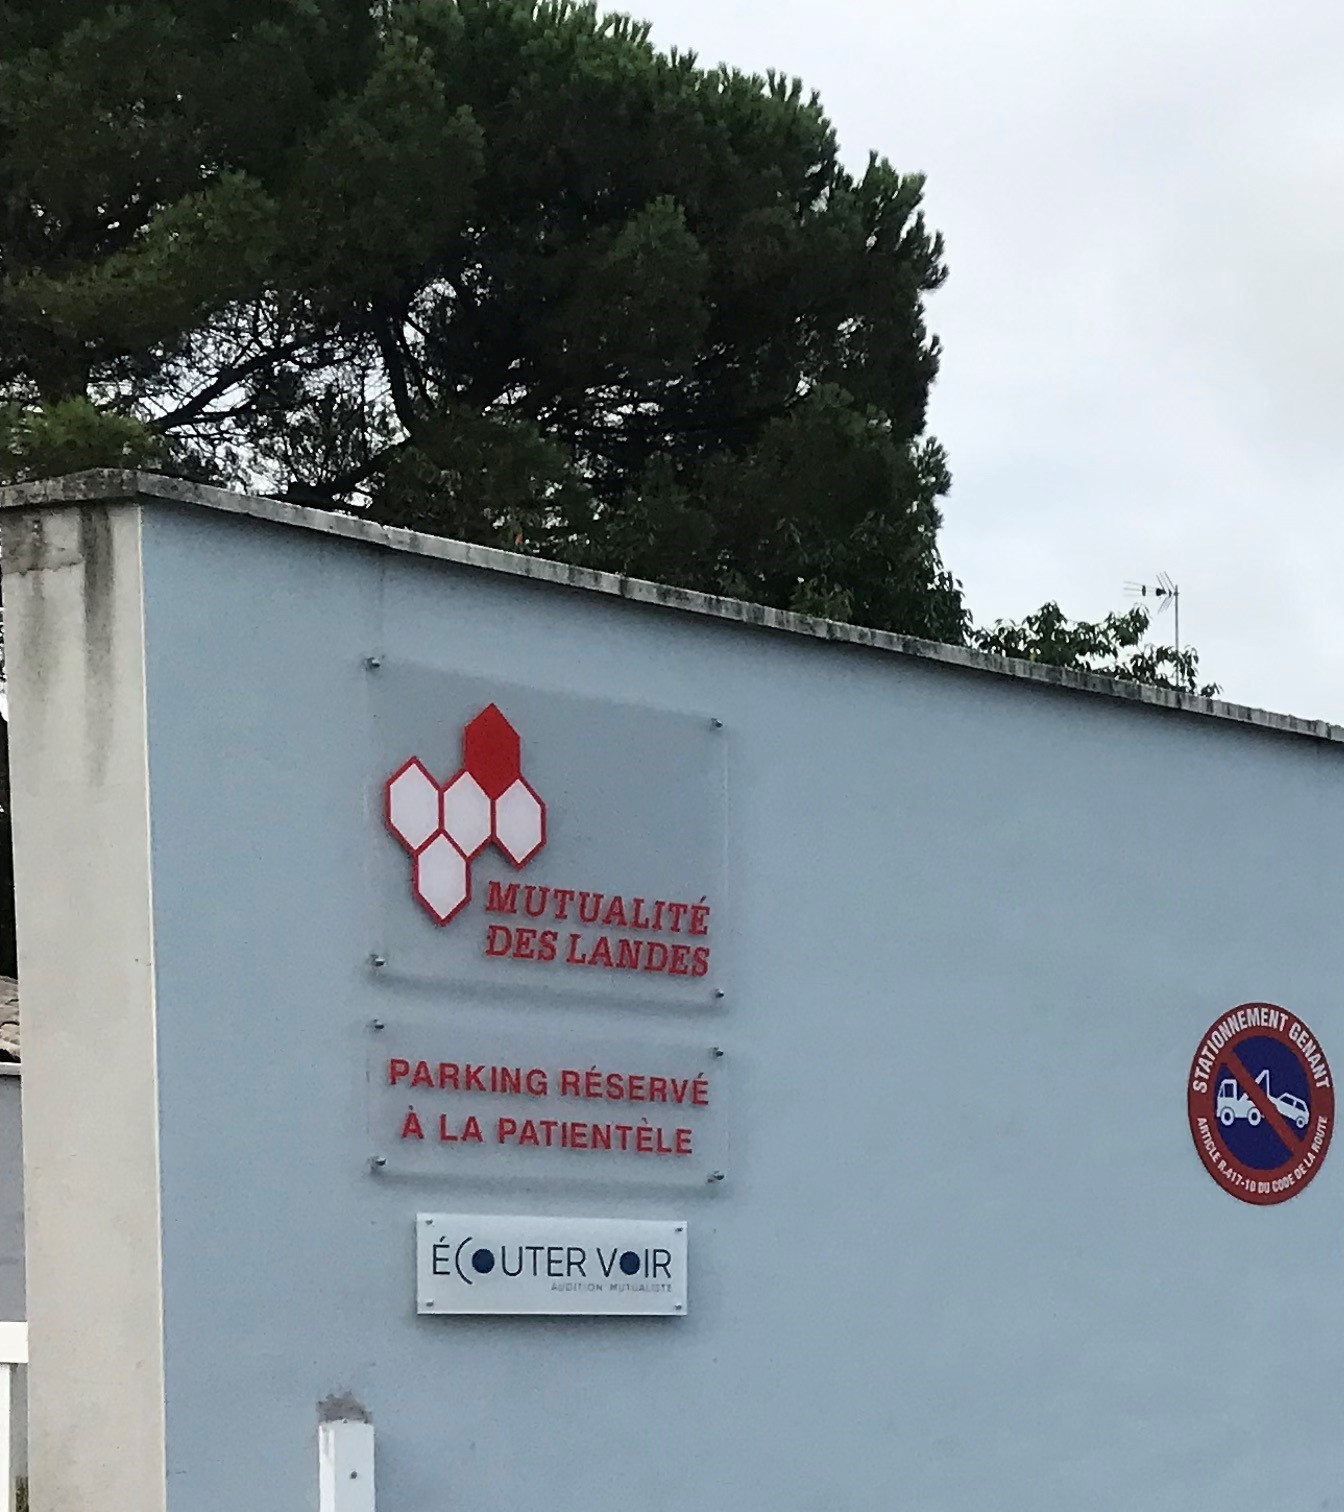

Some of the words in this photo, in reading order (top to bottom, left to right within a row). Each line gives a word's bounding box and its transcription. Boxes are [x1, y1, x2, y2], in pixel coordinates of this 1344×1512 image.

[486, 881, 711, 936] MUTUALITÉ
[485, 924, 559, 961] DES
[565, 933, 711, 977] LANDES
[1193, 1007, 1289, 1094] STATIONNEMENT
[1288, 1022, 1331, 1089] GENANT
[388, 1058, 549, 1097] PARKING
[560, 1065, 710, 1106] RÉSERVÉ
[401, 1105, 425, 1141] À
[439, 1113, 485, 1143] LA
[497, 1117, 693, 1154] PATIENTÈLE
[1197, 1116, 1219, 1164] ARTICLE
[1258, 1181, 1270, 1194] DU
[1272, 1173, 1295, 1194] CODE
[1295, 1162, 1306, 1180] DE
[1304, 1151, 1316, 1168] LA
[1312, 1115, 1328, 1154] ROUTE
[432, 1236, 587, 1285] ÉCOUTER
[596, 1247, 673, 1279] VOIR
